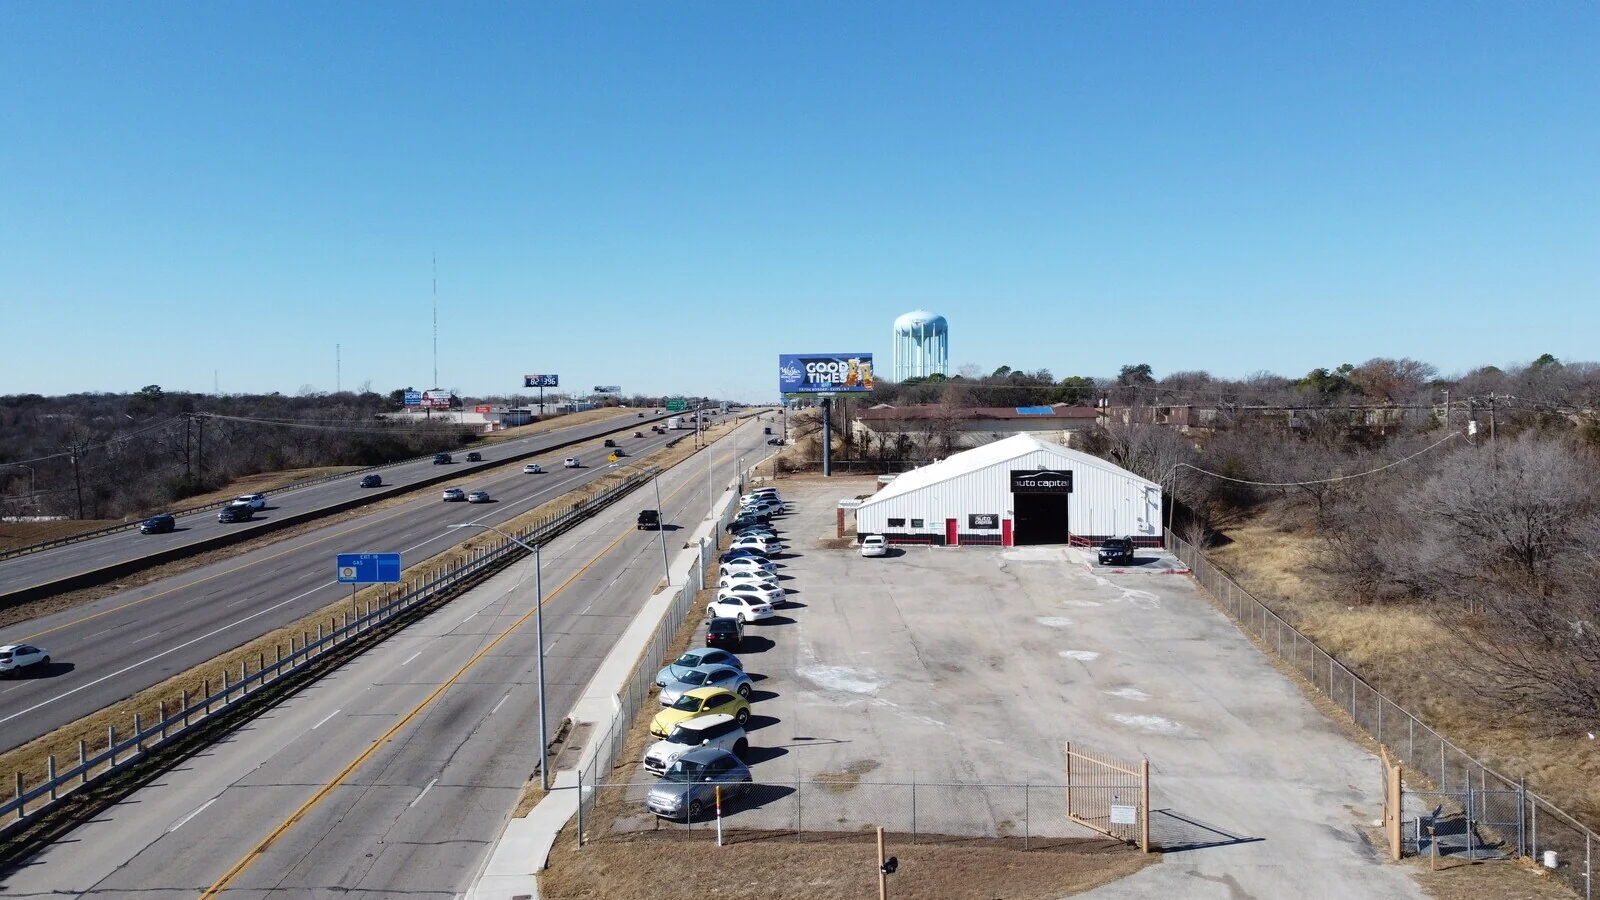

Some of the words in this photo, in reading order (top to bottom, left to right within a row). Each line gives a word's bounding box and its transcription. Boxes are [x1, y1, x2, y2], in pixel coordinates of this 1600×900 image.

[806, 362, 849, 373] GOOD
[544, 377, 556, 385] 396
[807, 373, 847, 383] TIMES
[1037, 480, 1069, 488] capital
